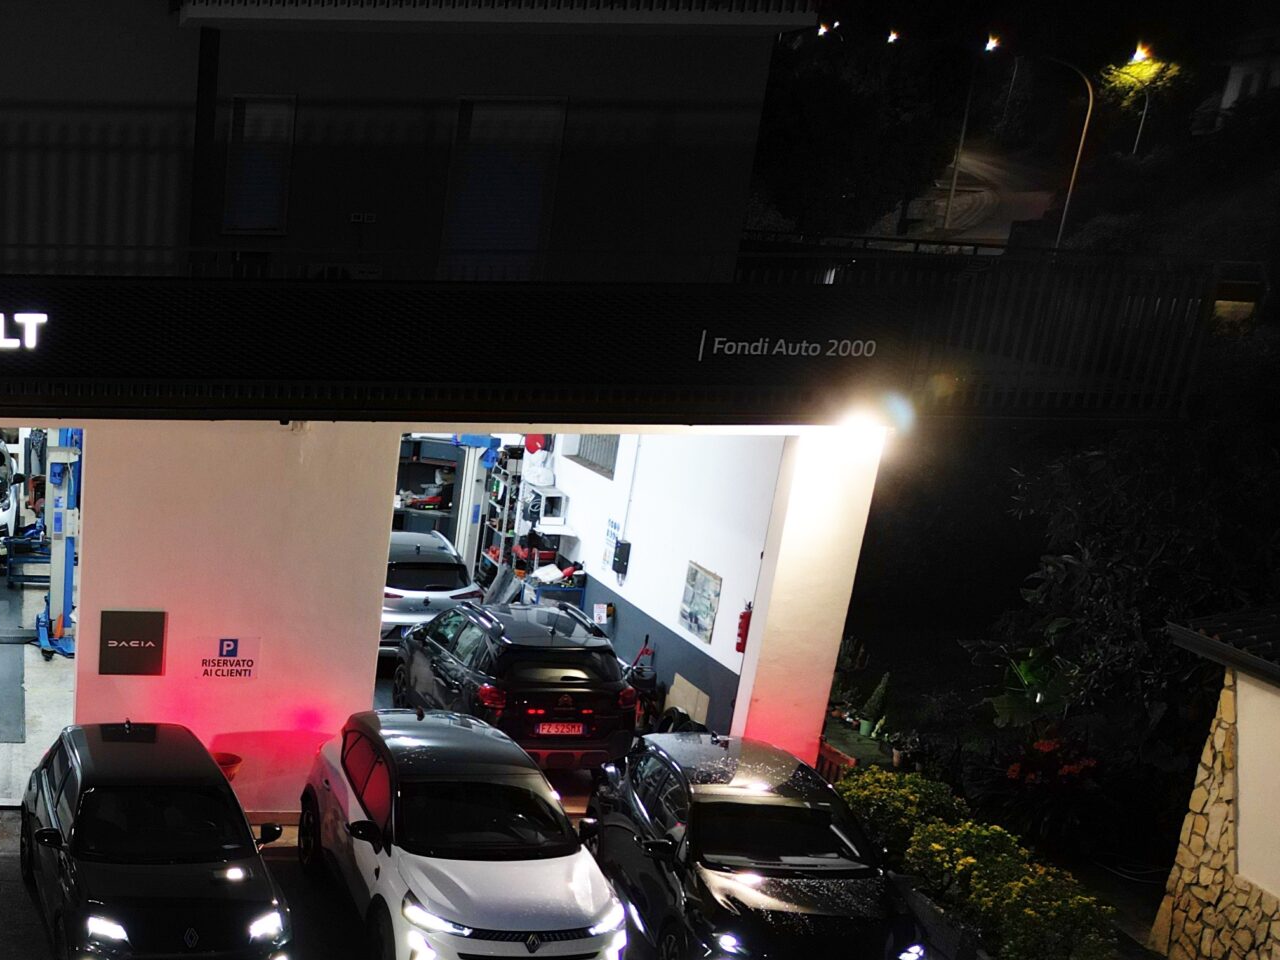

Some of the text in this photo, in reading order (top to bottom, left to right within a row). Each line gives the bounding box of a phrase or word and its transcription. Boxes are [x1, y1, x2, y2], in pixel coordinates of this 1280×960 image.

[712, 338, 876, 357] Fondi Auto 2000
[107, 640, 156, 648] DACIA
[201, 658, 254, 668] RISERVATO
[202, 668, 252, 677] AI CLIENTI
